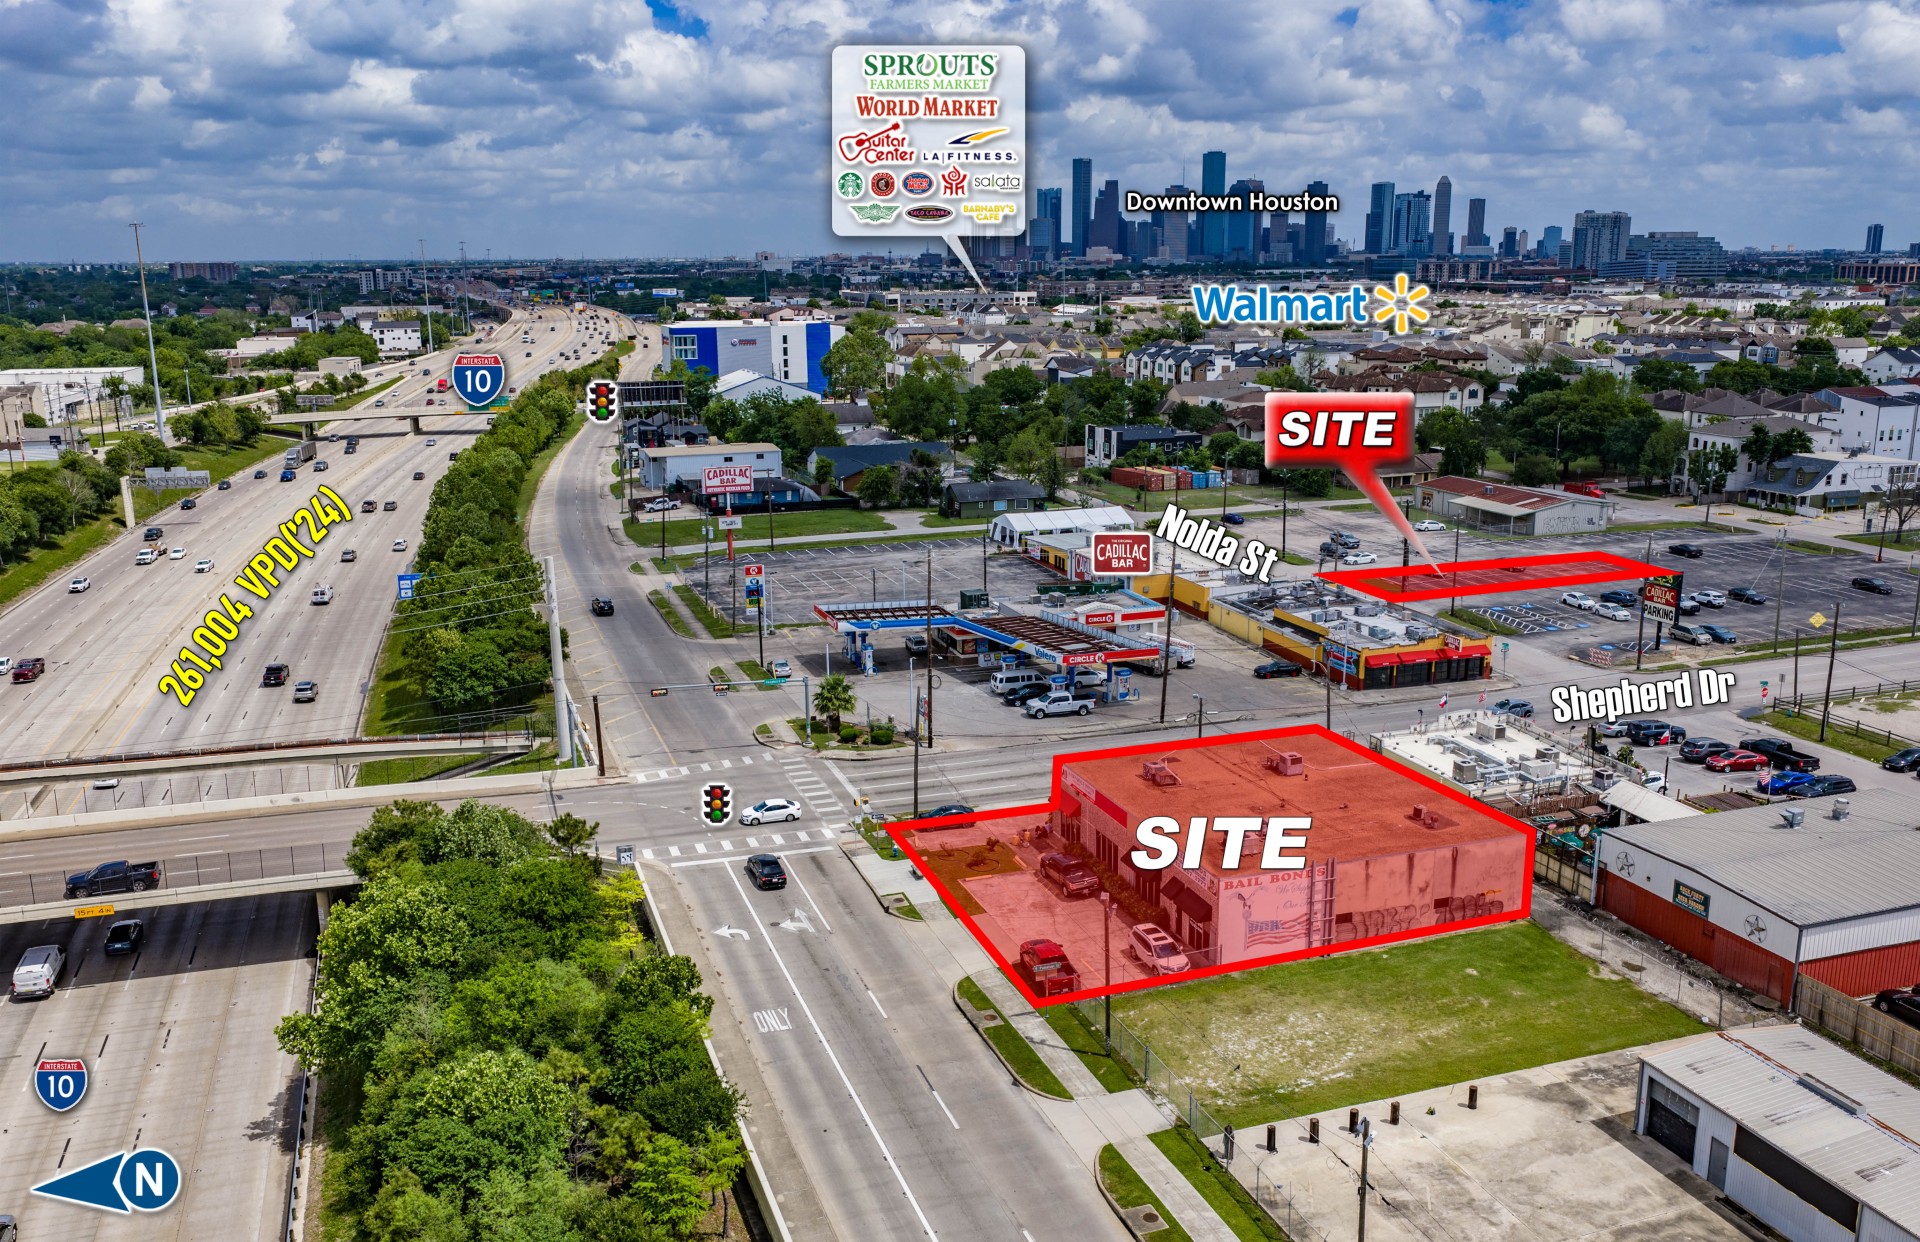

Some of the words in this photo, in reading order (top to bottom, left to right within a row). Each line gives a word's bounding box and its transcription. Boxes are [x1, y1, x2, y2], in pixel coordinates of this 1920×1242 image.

[707, 468, 749, 480] CADILLAC
[720, 477, 737, 485] BAR
[1646, 586, 1675, 603] CADILLAC
[1653, 596, 1666, 604] BAR
[1643, 604, 1674, 622] PARKING
[1034, 647, 1057, 662] Valero
[1069, 655, 1095, 663] CIRCLE
[1223, 877, 1263, 890] BAIL
[753, 1007, 793, 1032] ONLY
